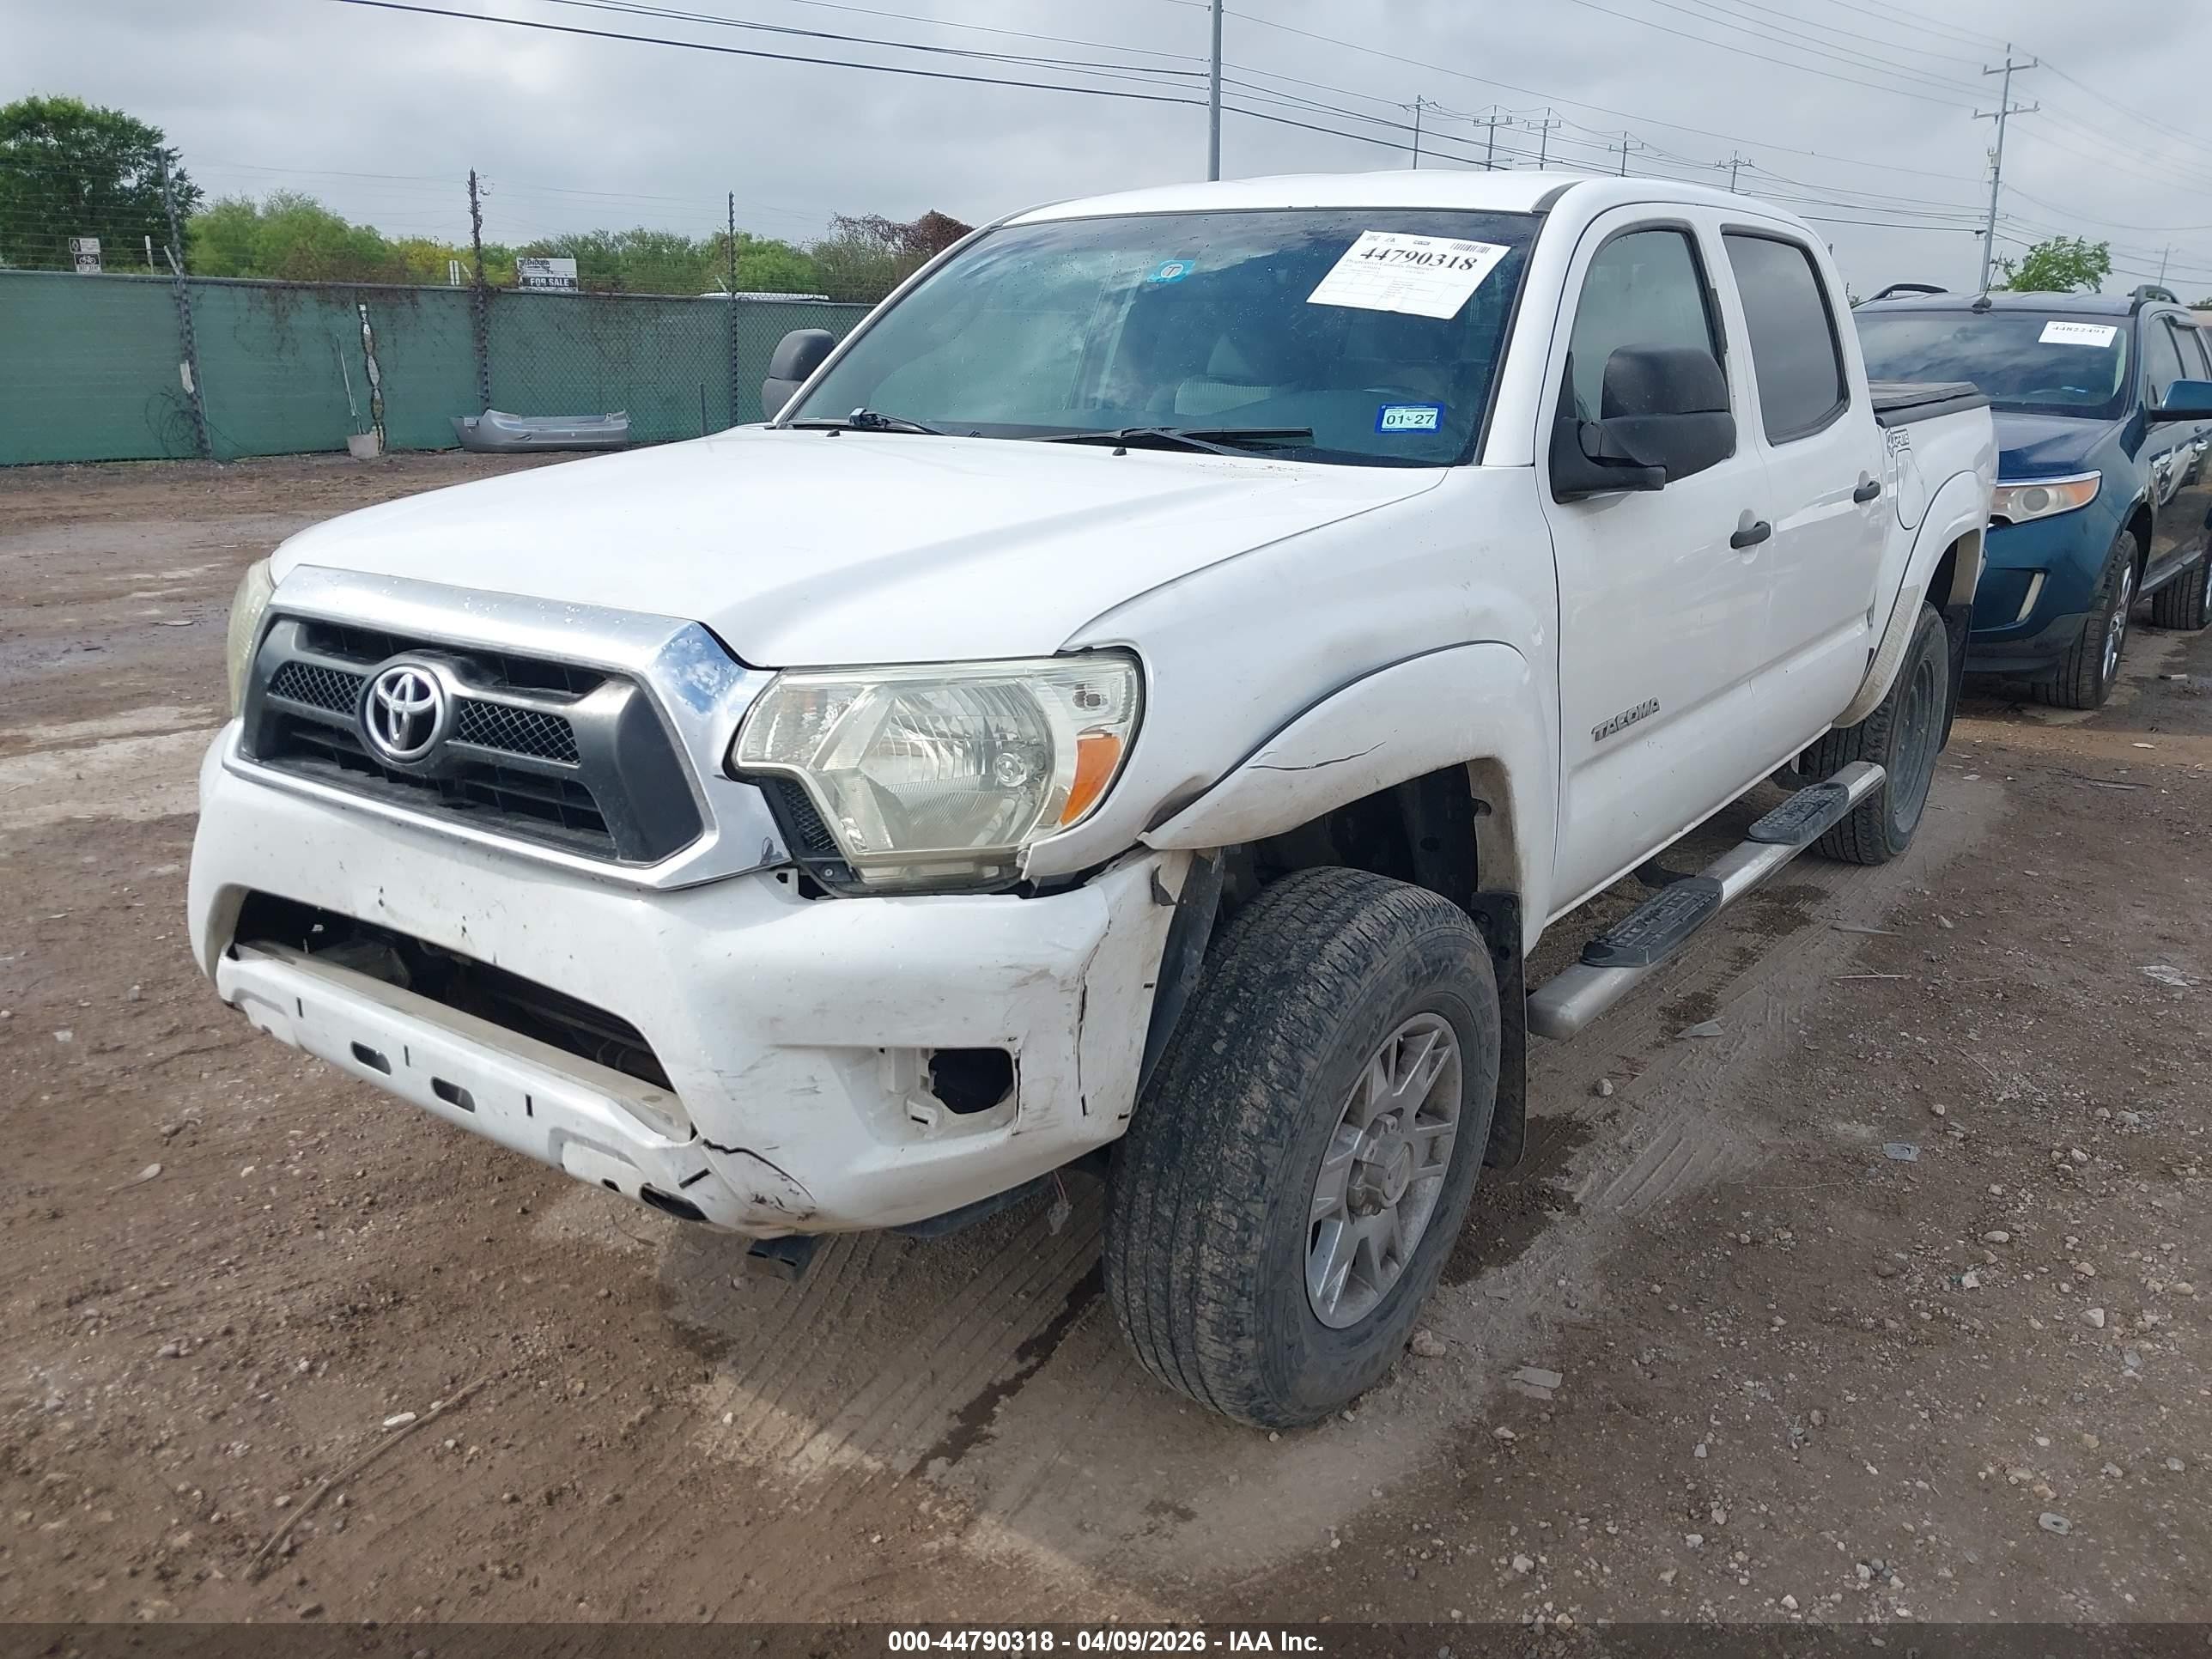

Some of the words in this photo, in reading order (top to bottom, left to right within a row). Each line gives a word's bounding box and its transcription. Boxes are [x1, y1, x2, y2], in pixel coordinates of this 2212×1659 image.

[1360, 246, 1478, 270] 44790318
[530, 277, 546, 286] FOR
[549, 277, 569, 287] SALE
[1386, 415, 1404, 425] 01
[1413, 414, 1435, 424] 27
[1590, 696, 1661, 742] TACOMA
